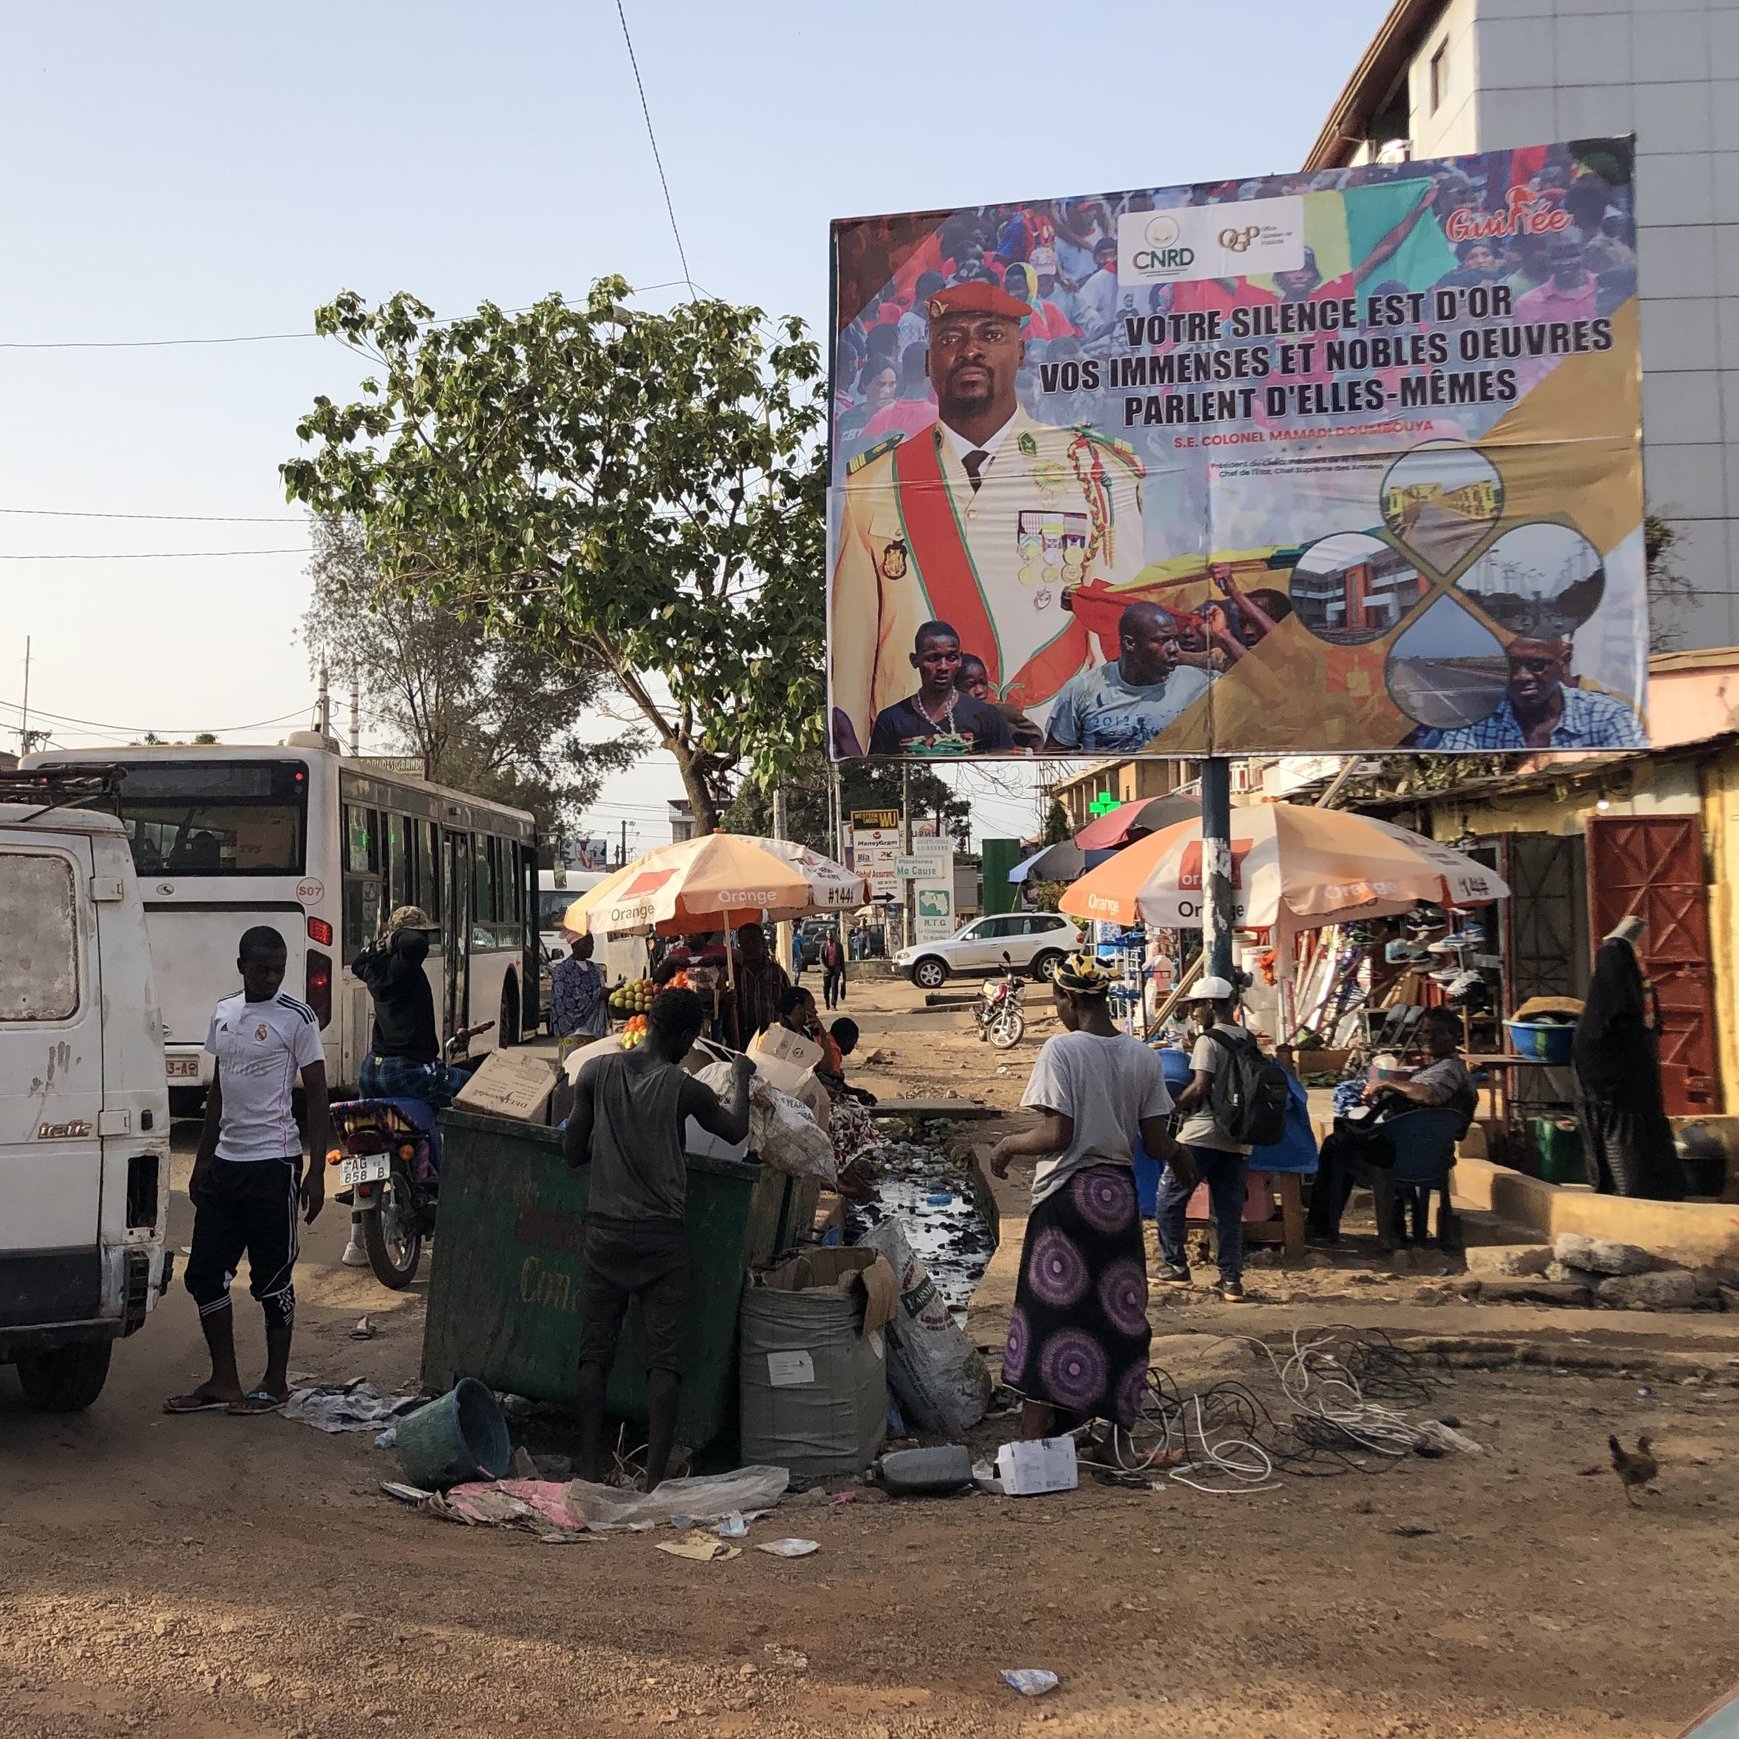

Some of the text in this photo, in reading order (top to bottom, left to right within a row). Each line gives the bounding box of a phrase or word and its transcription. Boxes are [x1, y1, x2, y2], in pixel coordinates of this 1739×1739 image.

[1133, 248, 1194, 269] CNRD
[1124, 284, 1513, 347] VOTRE SILENCE EST D'OR
[1038, 317, 1614, 393] VOS IMMENSES ET NOBLES OEUVRES
[1124, 368, 1517, 427] PARLENT D'ELLES-MÊMES
[1174, 437, 1198, 448] S.E.
[1202, 432, 1265, 447] COLONEL
[1219, 470, 1238, 478] Chef
[879, 812, 896, 828] WU
[857, 852, 870, 861] Ria
[896, 866, 909, 875] Ma
[299, 886, 322, 897] S07
[718, 890, 777, 905] Orange
[1088, 893, 1120, 916] Orange
[611, 904, 656, 922] Orange
[352, 1157, 367, 1171] AG
[345, 1167, 385, 1184] 858 B
